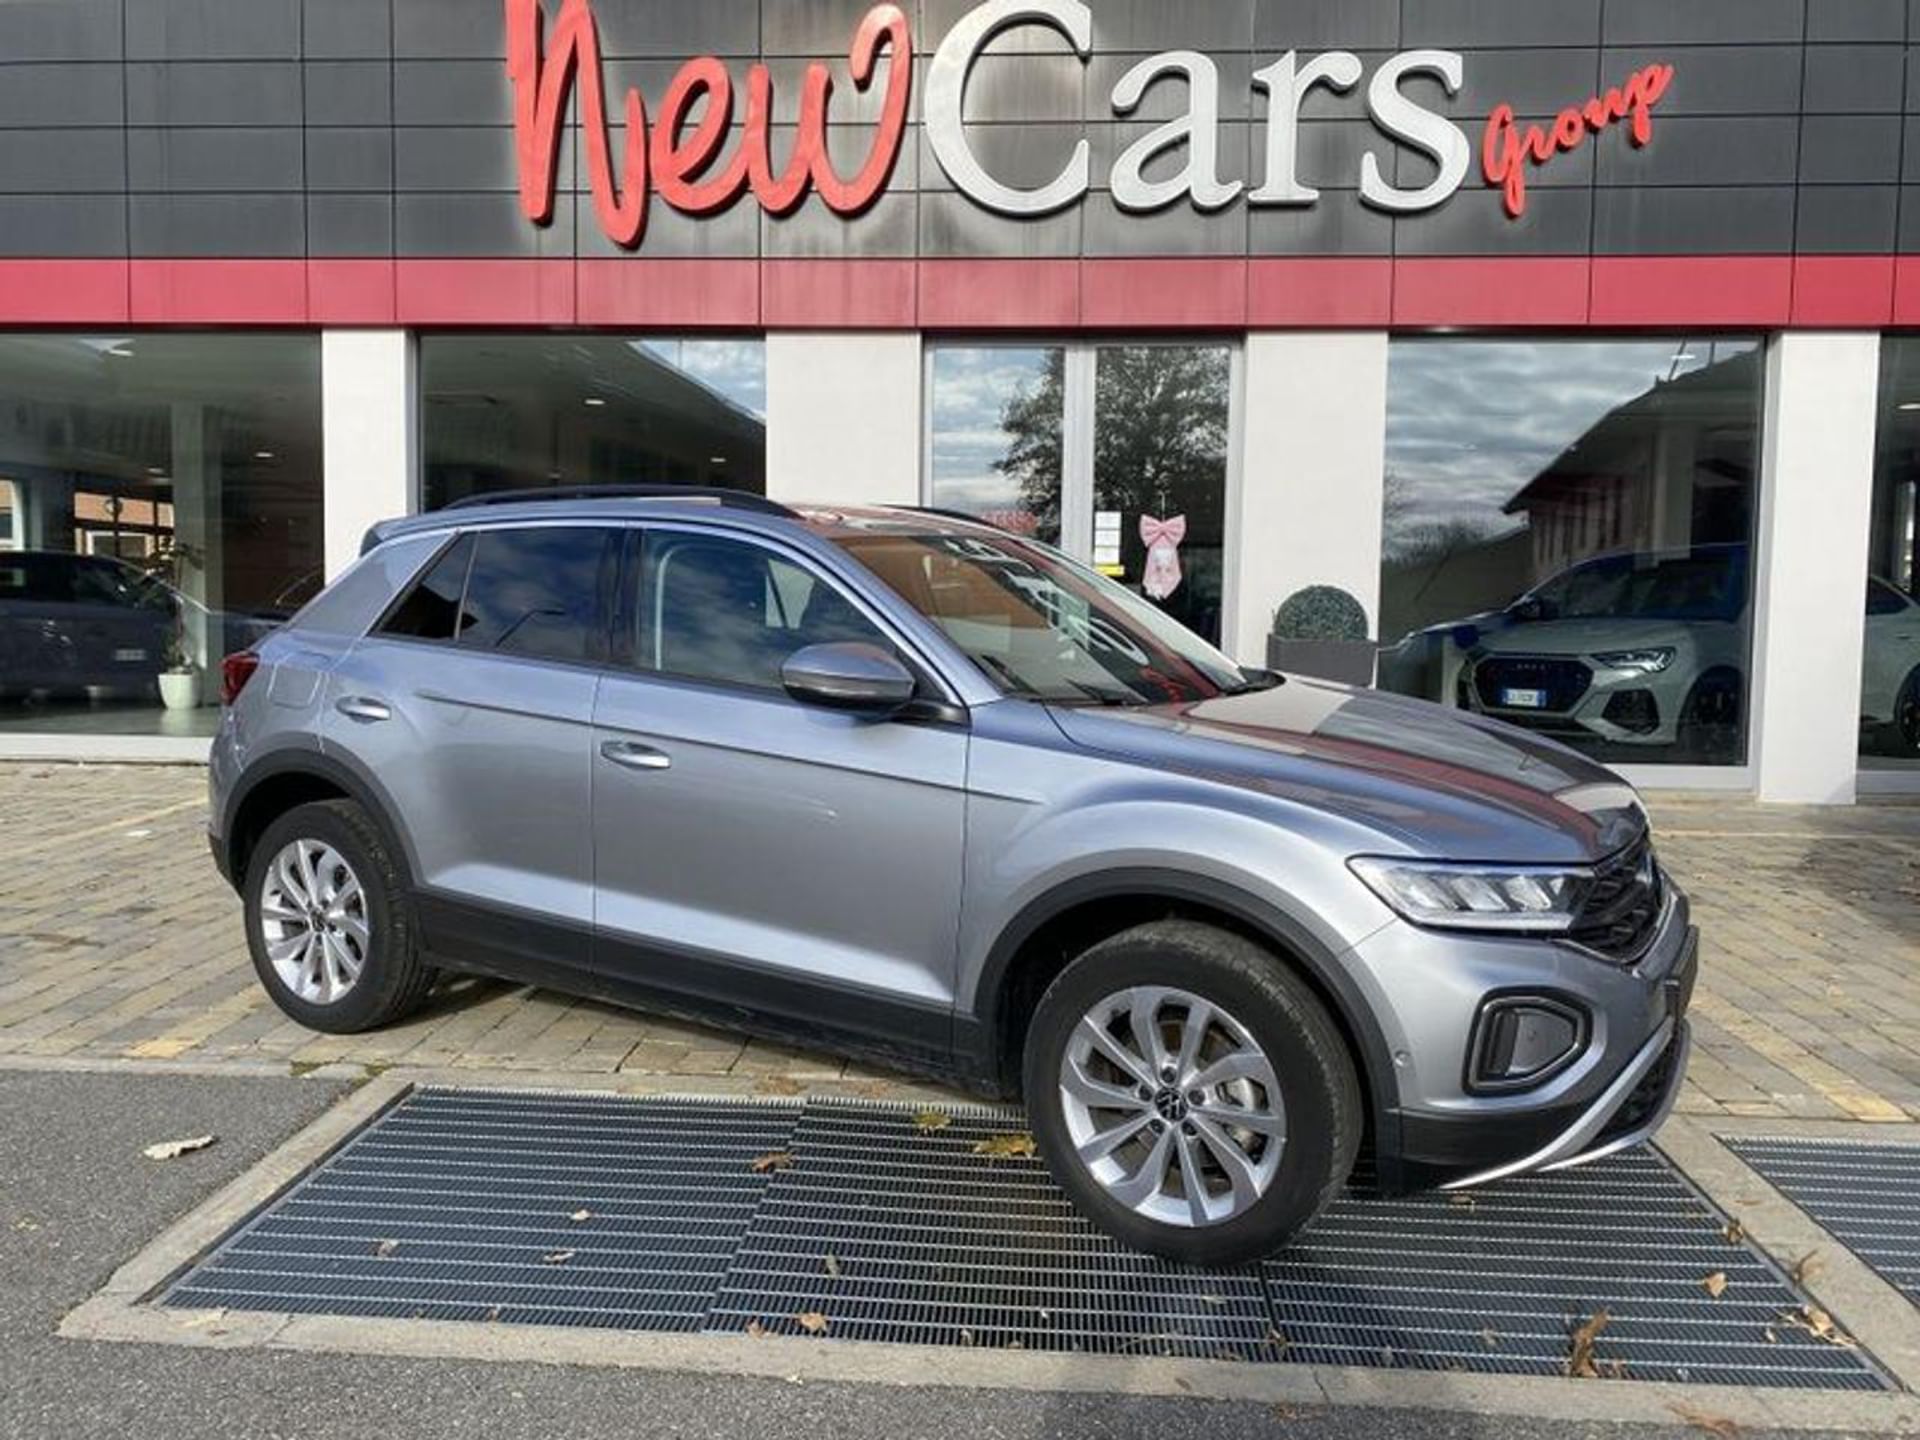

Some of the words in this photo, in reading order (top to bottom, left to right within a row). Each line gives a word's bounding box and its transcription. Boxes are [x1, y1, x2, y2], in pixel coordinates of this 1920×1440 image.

[505, 0, 911, 246] New
[924, 0, 1471, 215] Cars
[1482, 63, 1675, 217] Group
